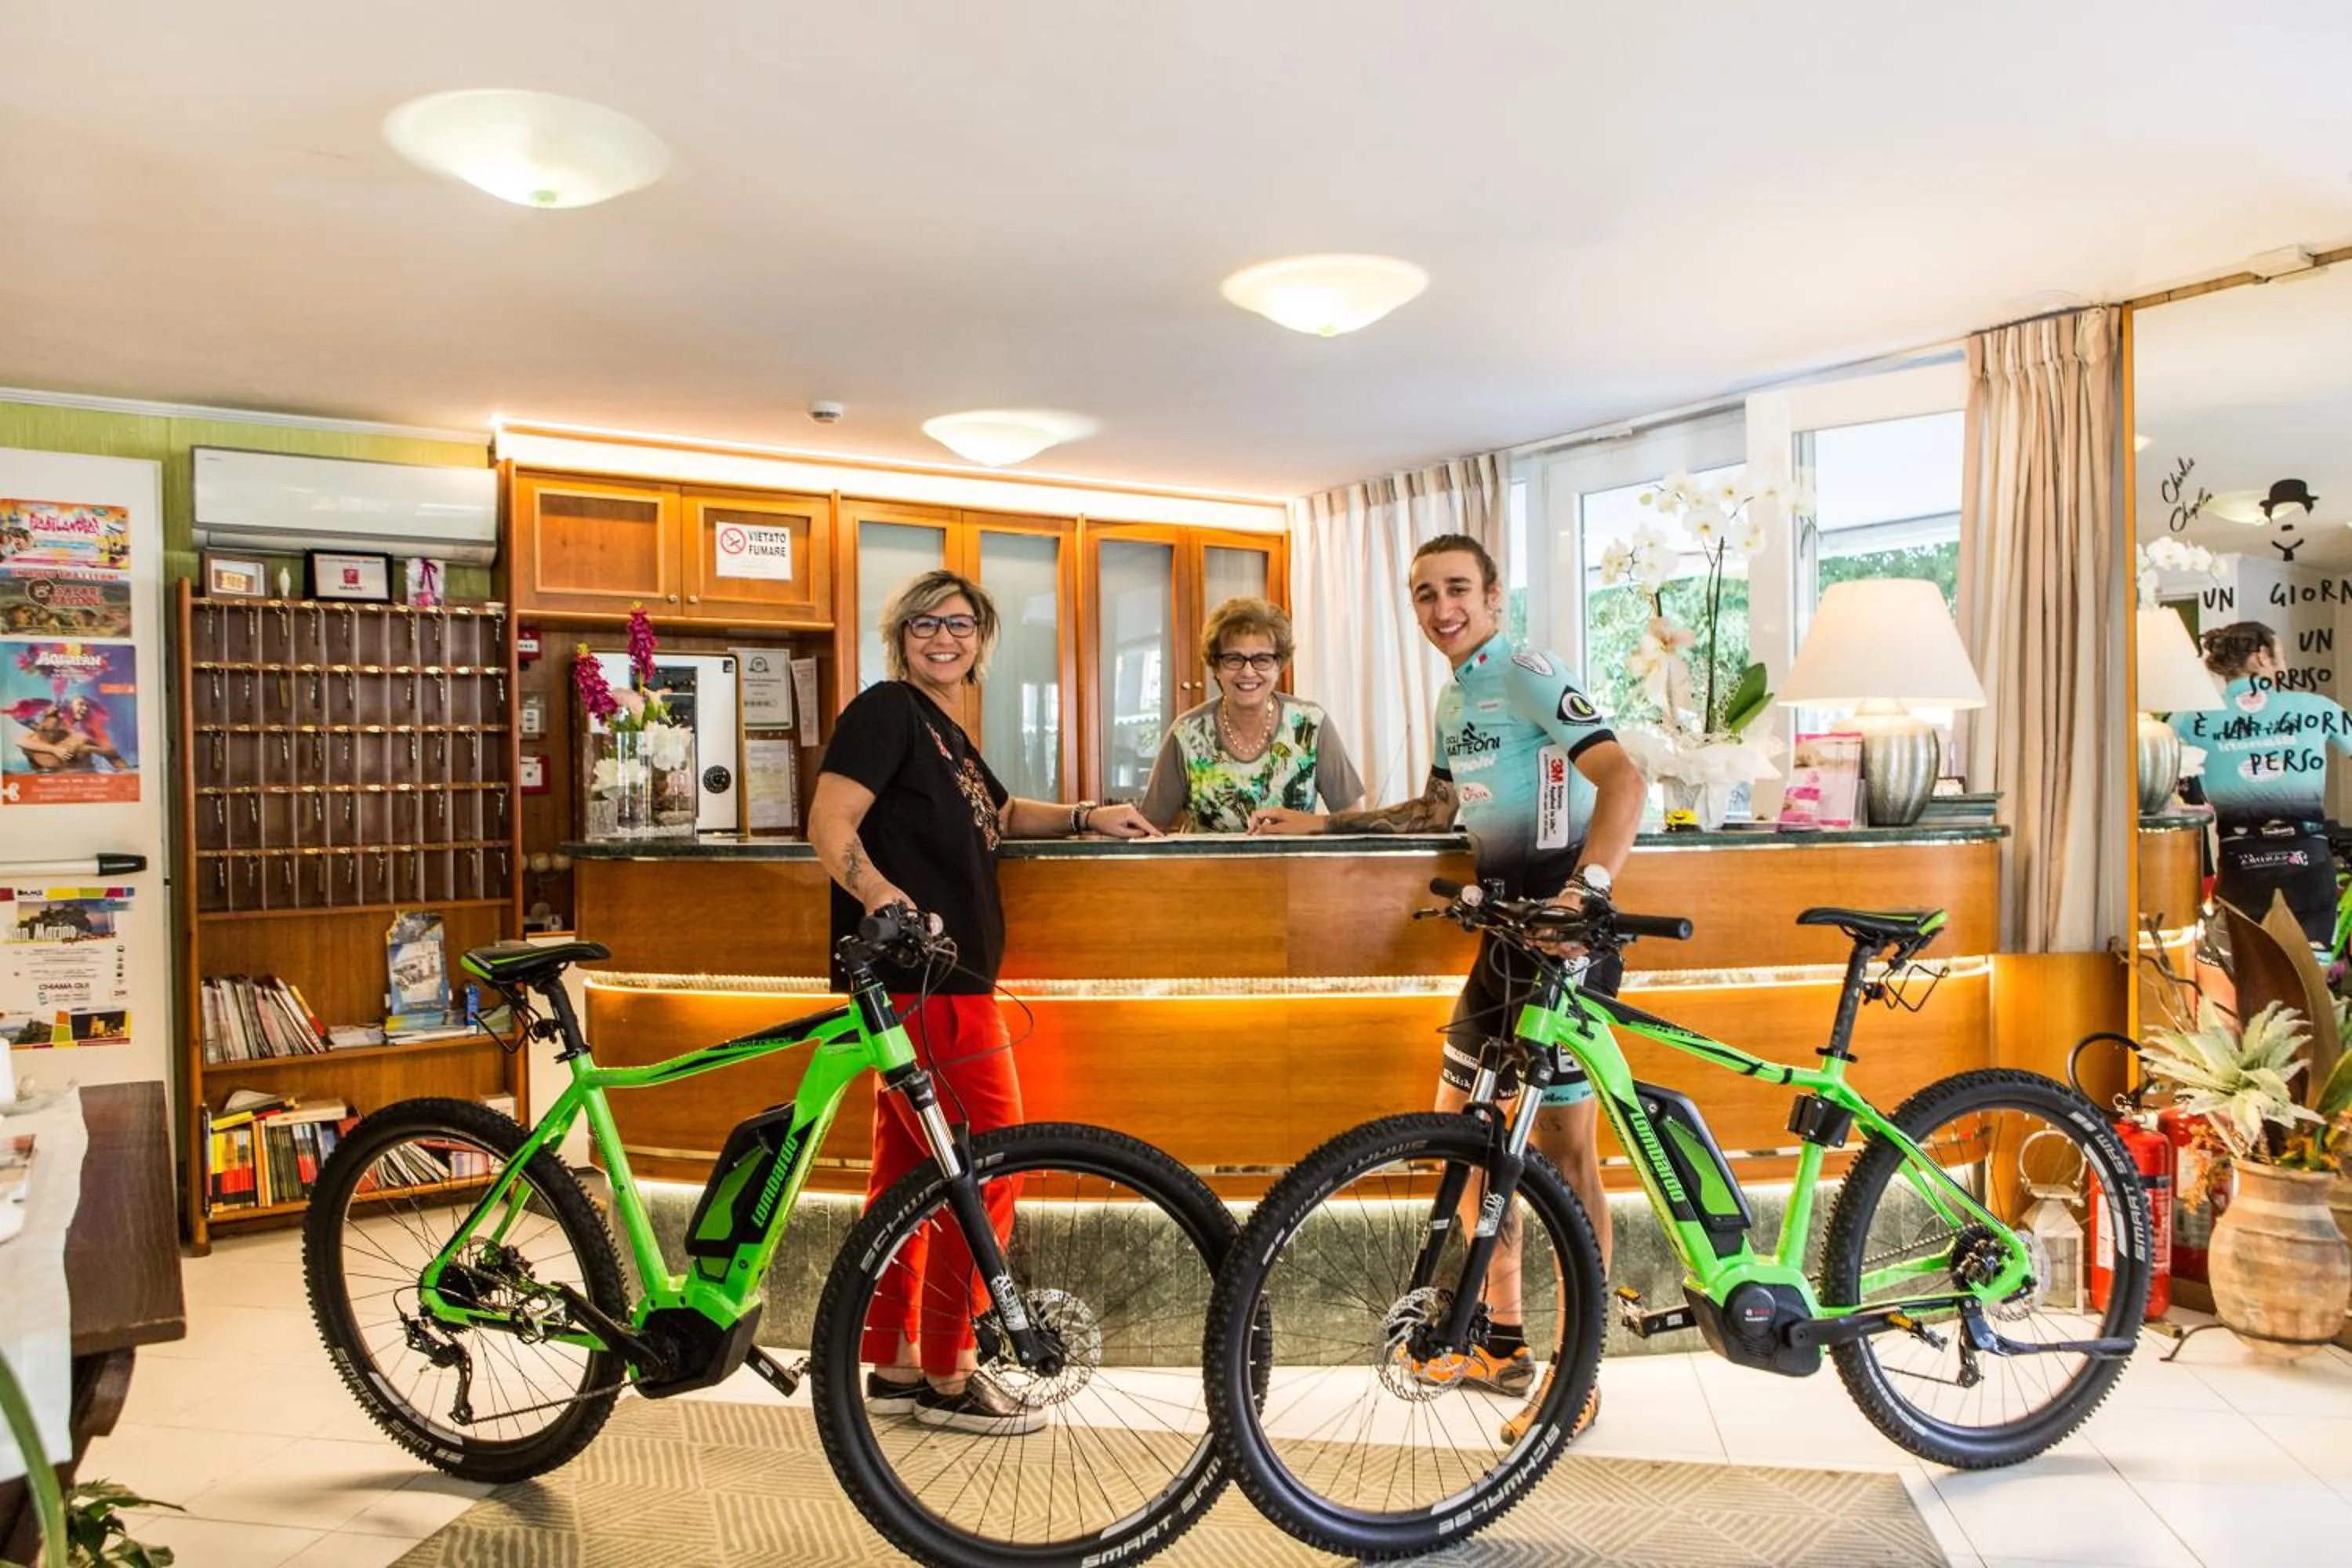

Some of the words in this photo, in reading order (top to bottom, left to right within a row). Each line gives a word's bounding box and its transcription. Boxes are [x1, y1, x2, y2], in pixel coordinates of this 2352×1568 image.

[2169, 487, 2213, 533] Chaplin
[748, 545, 786, 557] FUMARE
[749, 531, 786, 543] VIETATO
[2203, 586, 2234, 612] UN
[2298, 627, 2333, 655] UN
[2249, 666, 2332, 698] SORRISO
[1551, 758, 1566, 783] 3M
[2249, 747, 2324, 775] PERSO
[2095, 1133, 2129, 1175] SAM
[2122, 1181, 2147, 1264] SMART
[334, 1345, 387, 1415] SMART
[390, 1418, 434, 1454] SAM
[1178, 1455, 1223, 1516] SAM
[1438, 1421, 1562, 1536] SCHWALBE
[1080, 1515, 1173, 1568] SMART
